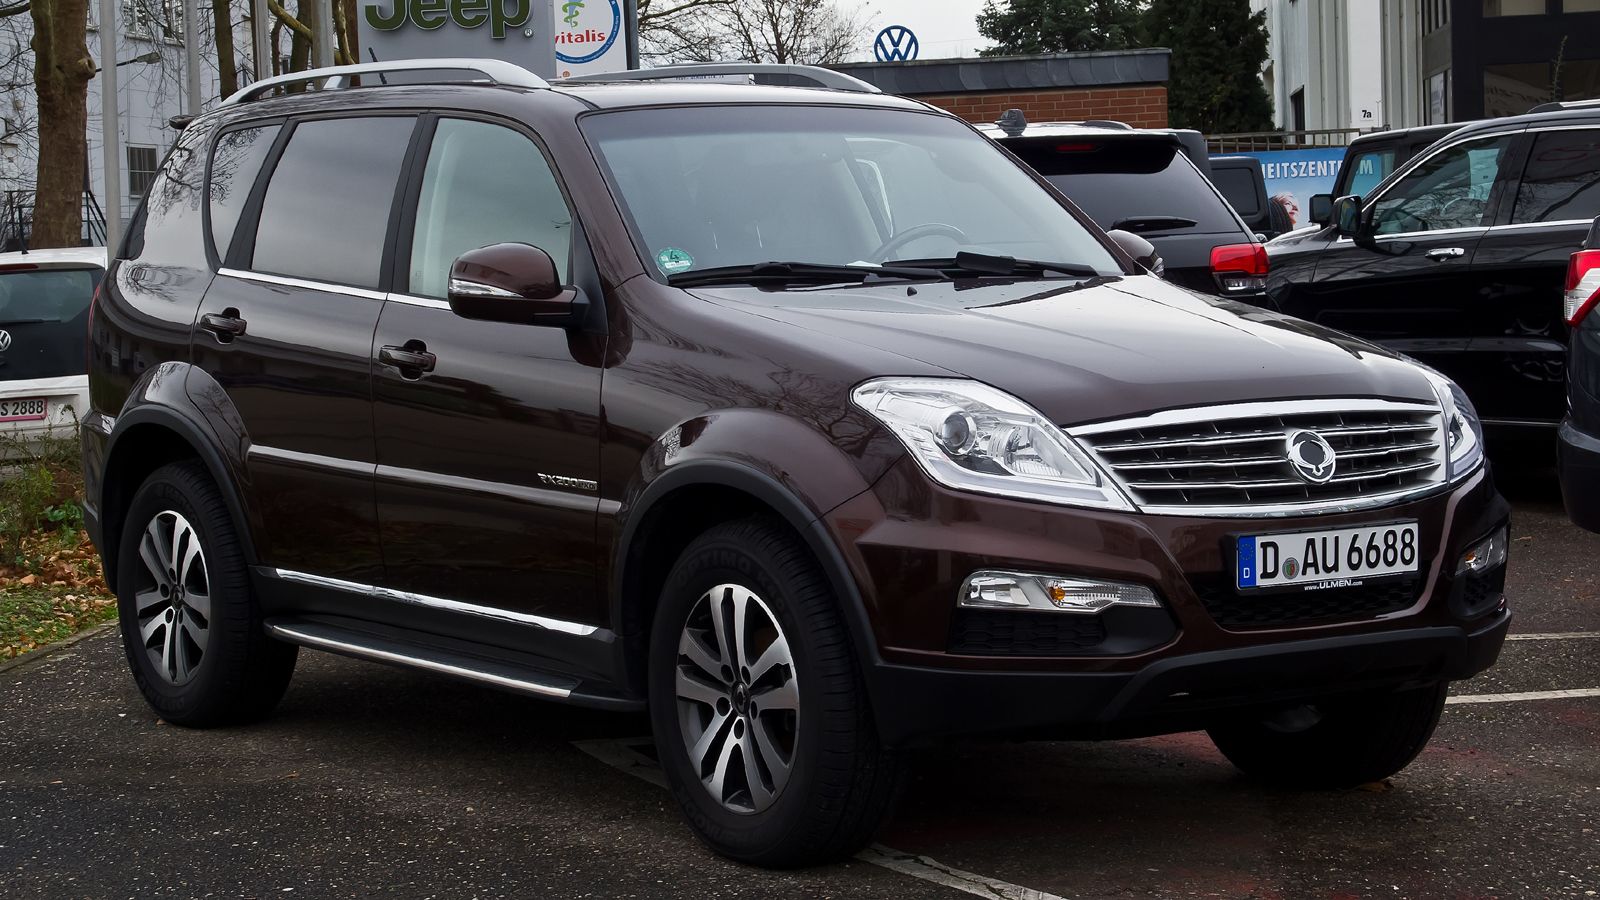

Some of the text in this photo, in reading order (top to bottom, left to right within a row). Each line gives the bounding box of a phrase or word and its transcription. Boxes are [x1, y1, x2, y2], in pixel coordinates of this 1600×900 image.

[364, 0, 532, 39] Jeep
[1361, 109, 1372, 119] 7a
[0, 400, 44, 416] S 2888
[1259, 528, 1416, 580] D AU 6688
[1243, 567, 1251, 579] D
[1304, 579, 1363, 591] www.ULMEN.com
